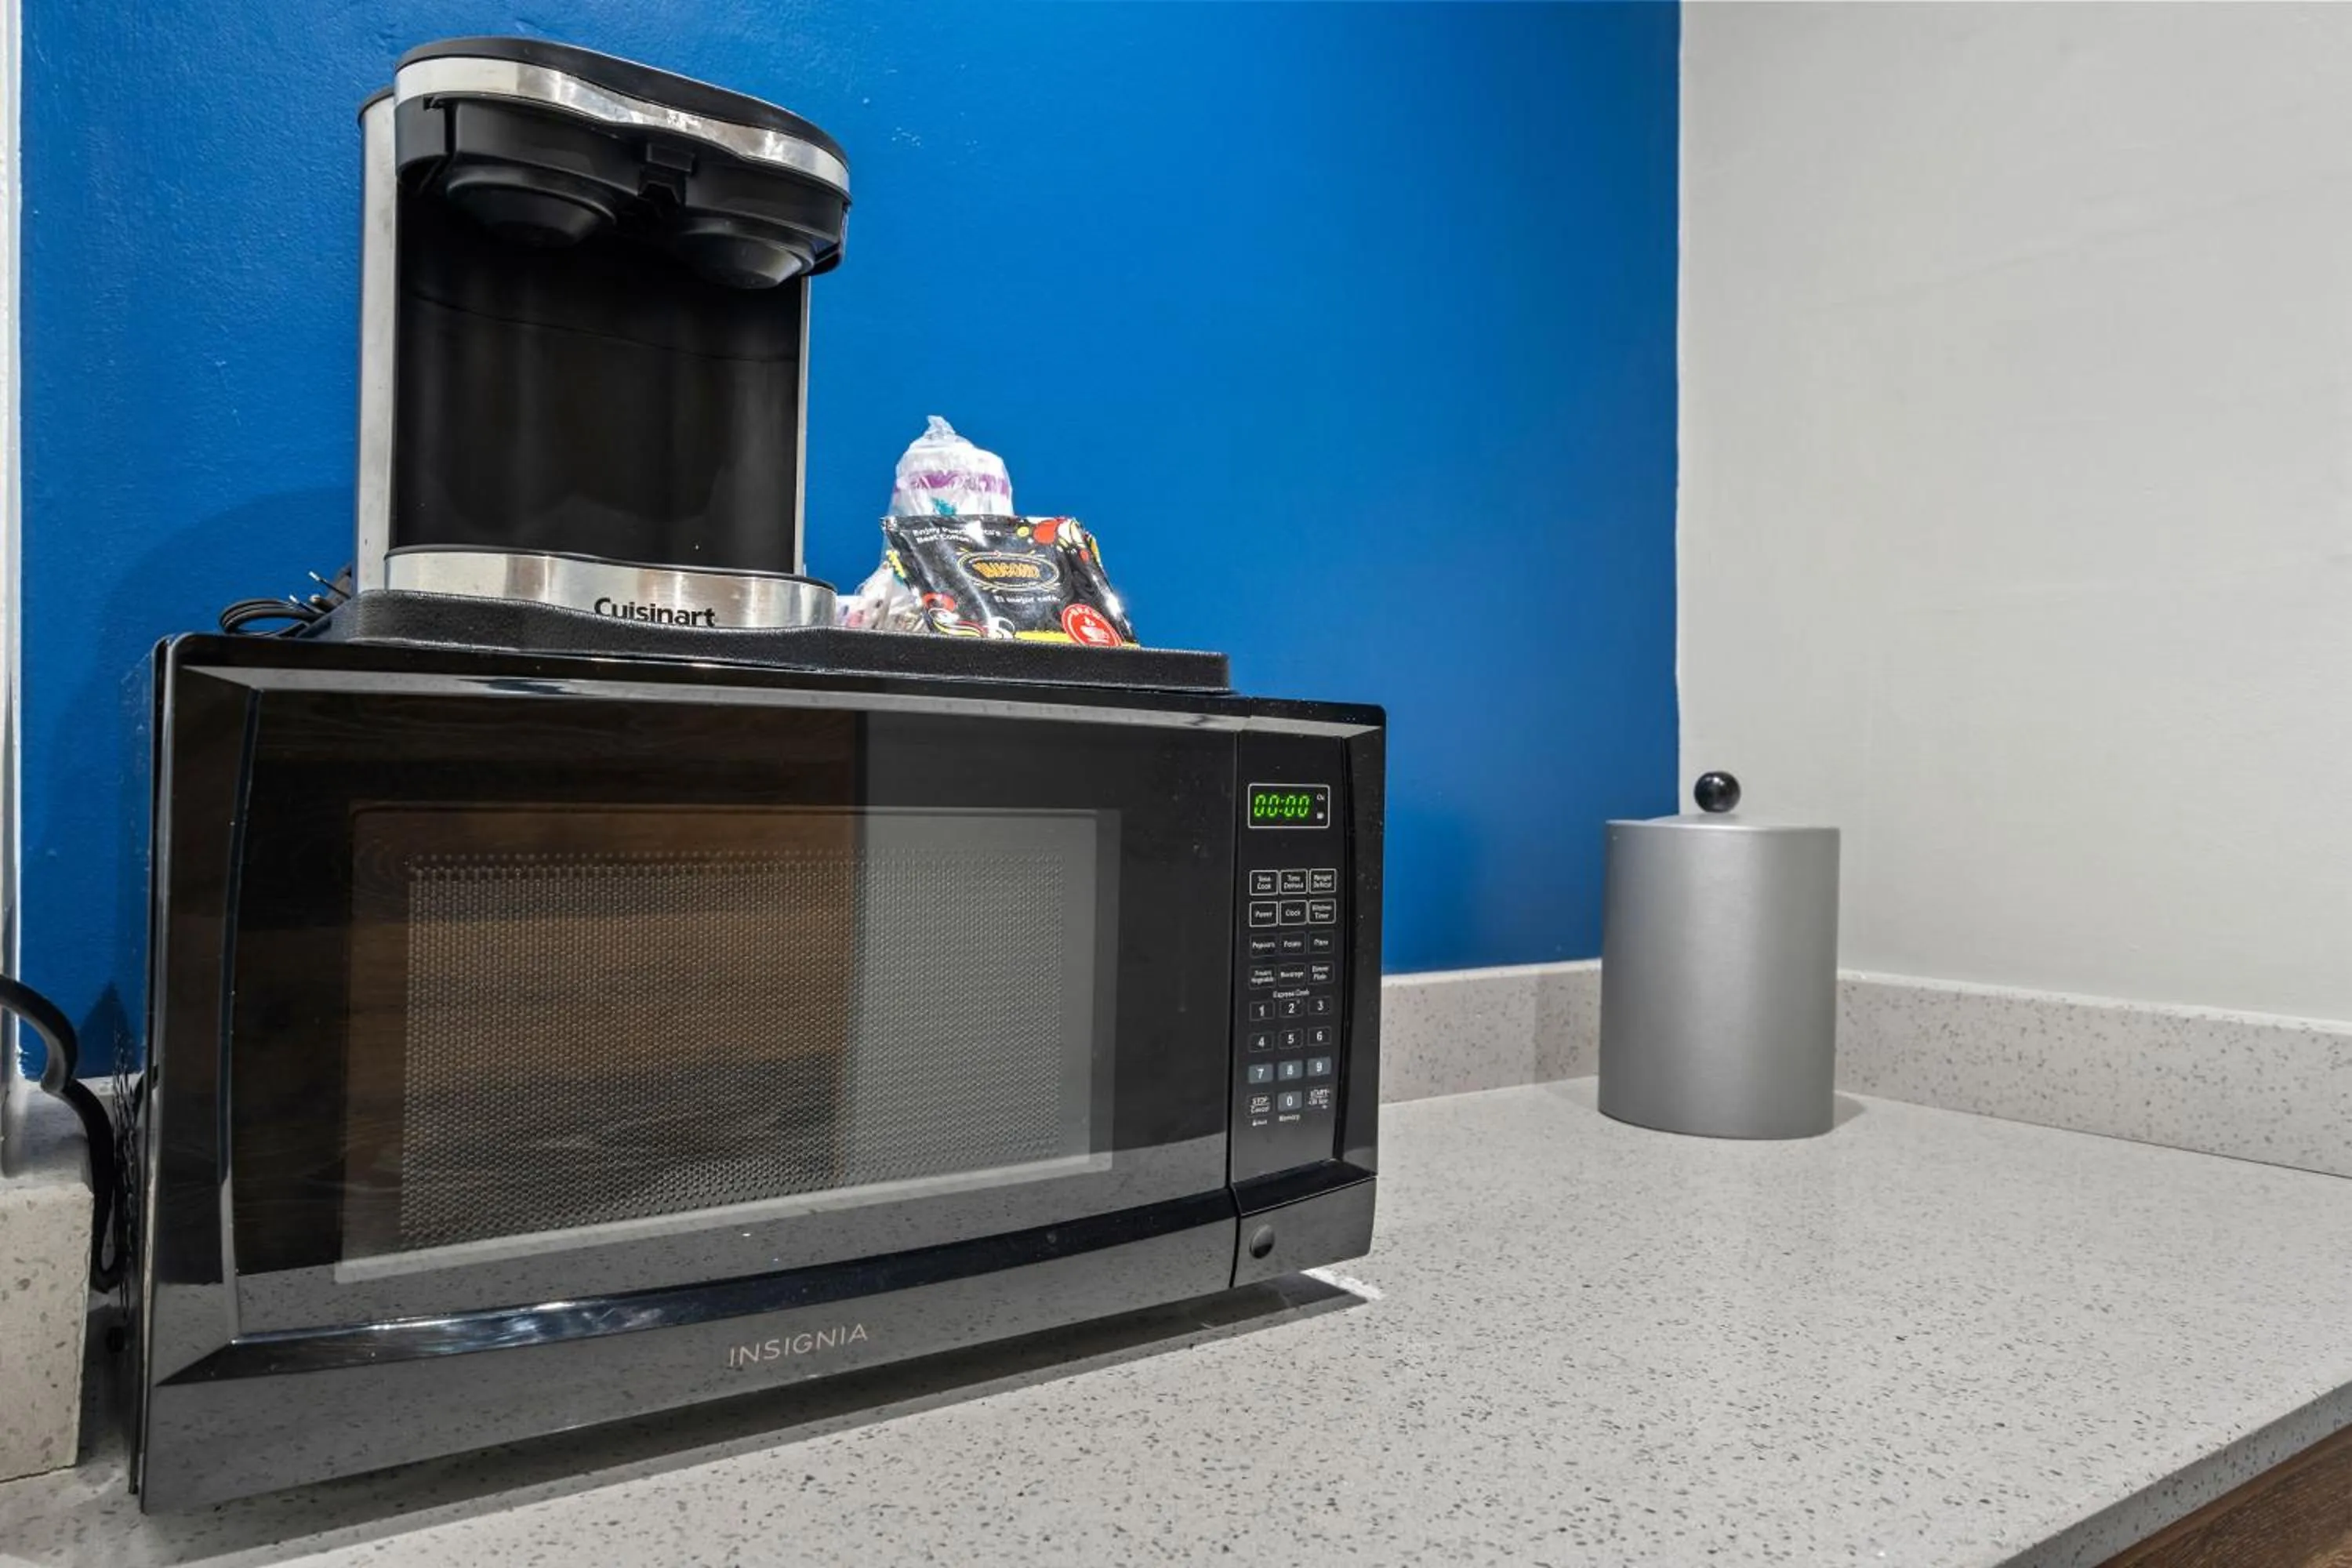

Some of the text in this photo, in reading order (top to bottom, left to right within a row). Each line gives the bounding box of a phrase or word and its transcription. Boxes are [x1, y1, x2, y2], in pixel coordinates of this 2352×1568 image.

[593, 597, 716, 627] Cuisinart
[1254, 794, 1310, 818] 00:00
[1258, 1004, 1265, 1017] 1
[1288, 1003, 1295, 1014] 2
[1316, 1000, 1324, 1011] 3
[1287, 1033, 1294, 1044] 5
[1316, 1030, 1323, 1041] 6
[1258, 1036, 1265, 1047] 4
[1287, 1064, 1294, 1076] 8
[1316, 1062, 1323, 1073] 9
[1257, 1068, 1265, 1080] 7
[1287, 1095, 1293, 1106] 0
[729, 1323, 869, 1367] INSIGNIA
